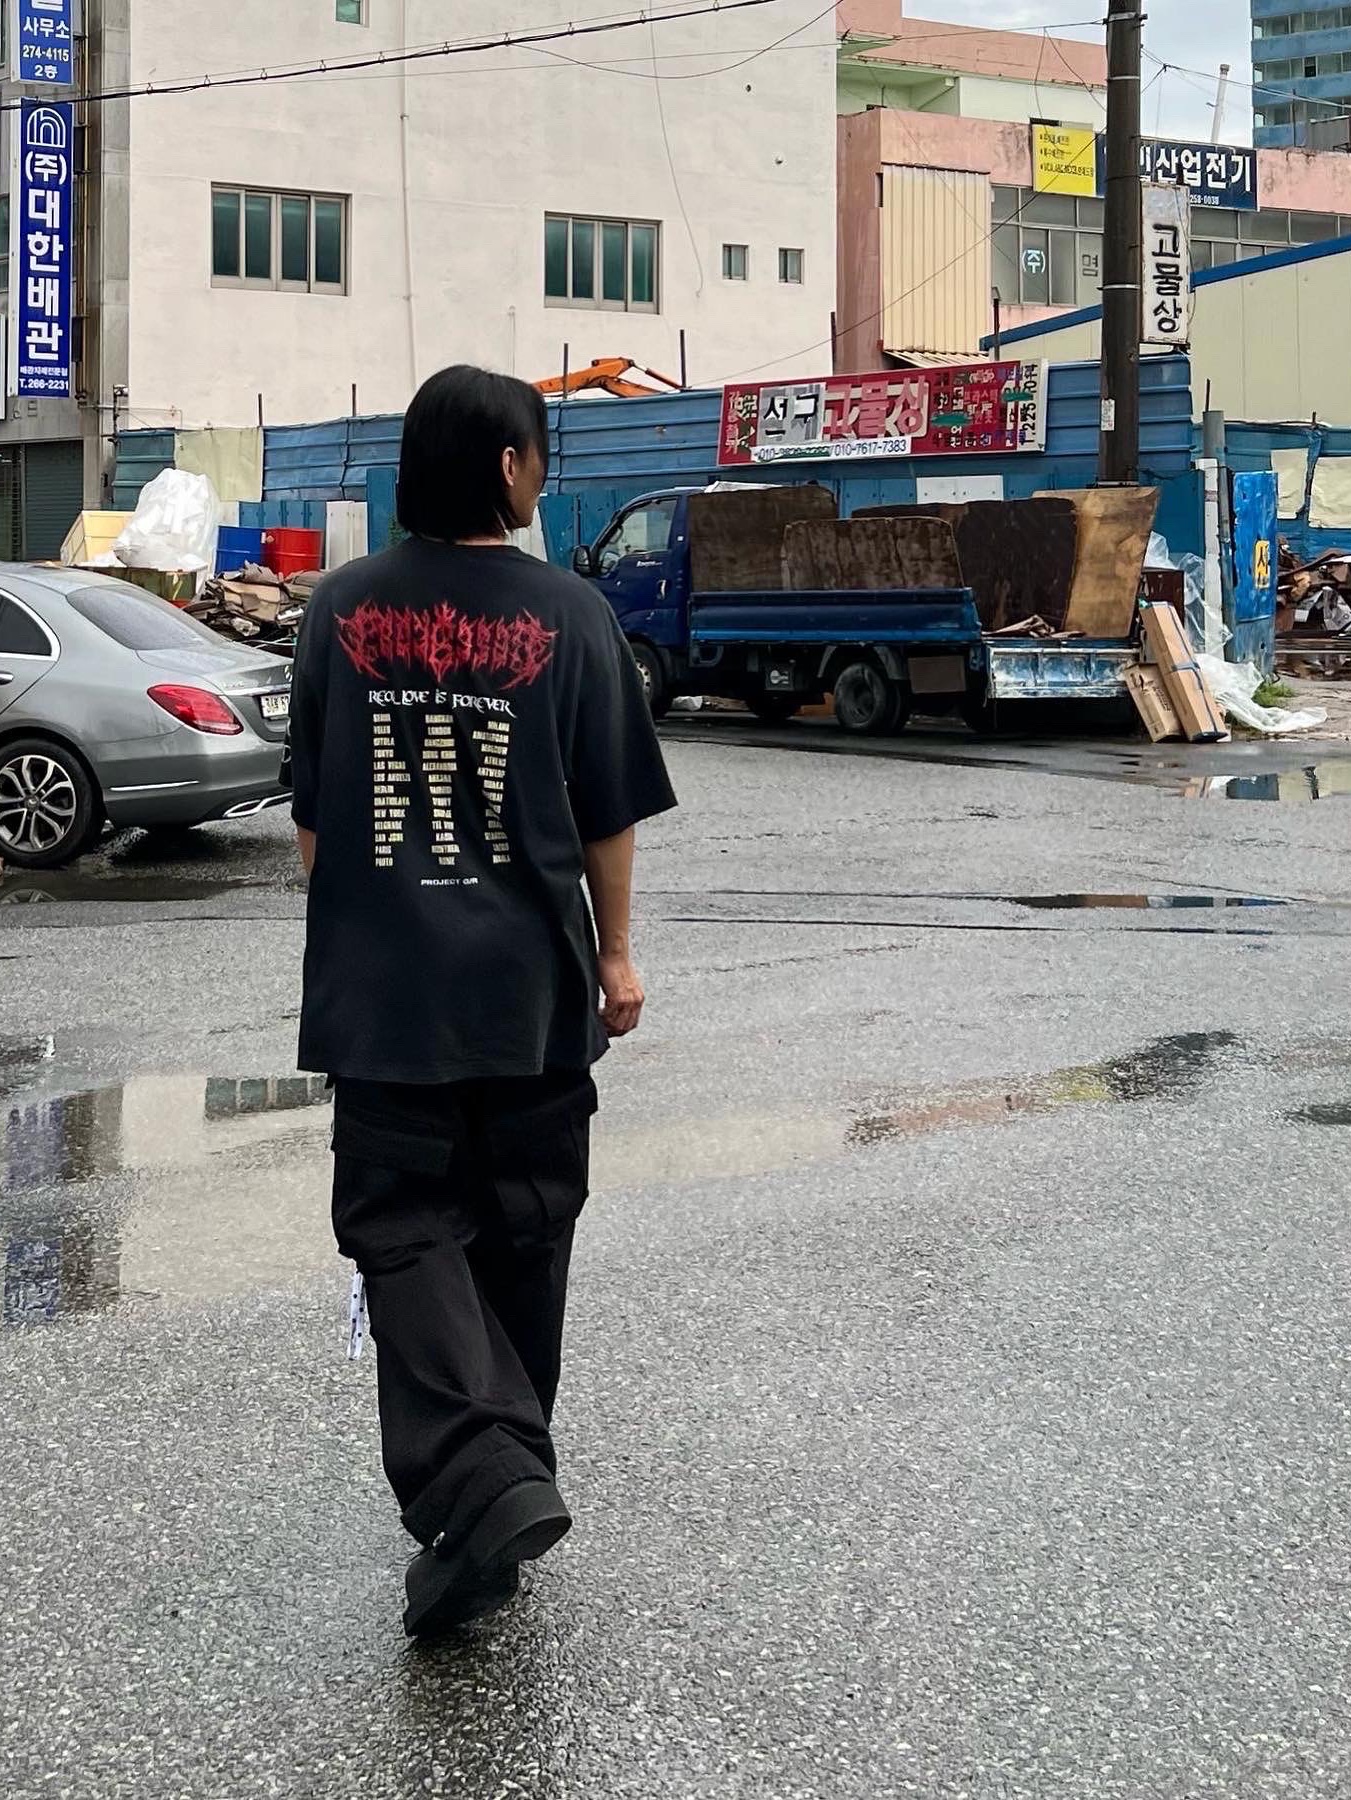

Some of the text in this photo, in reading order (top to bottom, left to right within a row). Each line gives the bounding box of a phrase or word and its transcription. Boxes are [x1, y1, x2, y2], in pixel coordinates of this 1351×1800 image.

[23, 16, 70, 39] 사무소
[23, 45, 69, 62] 274-4115
[35, 64, 58, 79] 2층
[1022, 249, 1046, 274] (주)
[1152, 223, 1183, 333] 고물상
[402, 690, 430, 706] LOVE
[452, 693, 517, 718] FOREVER
